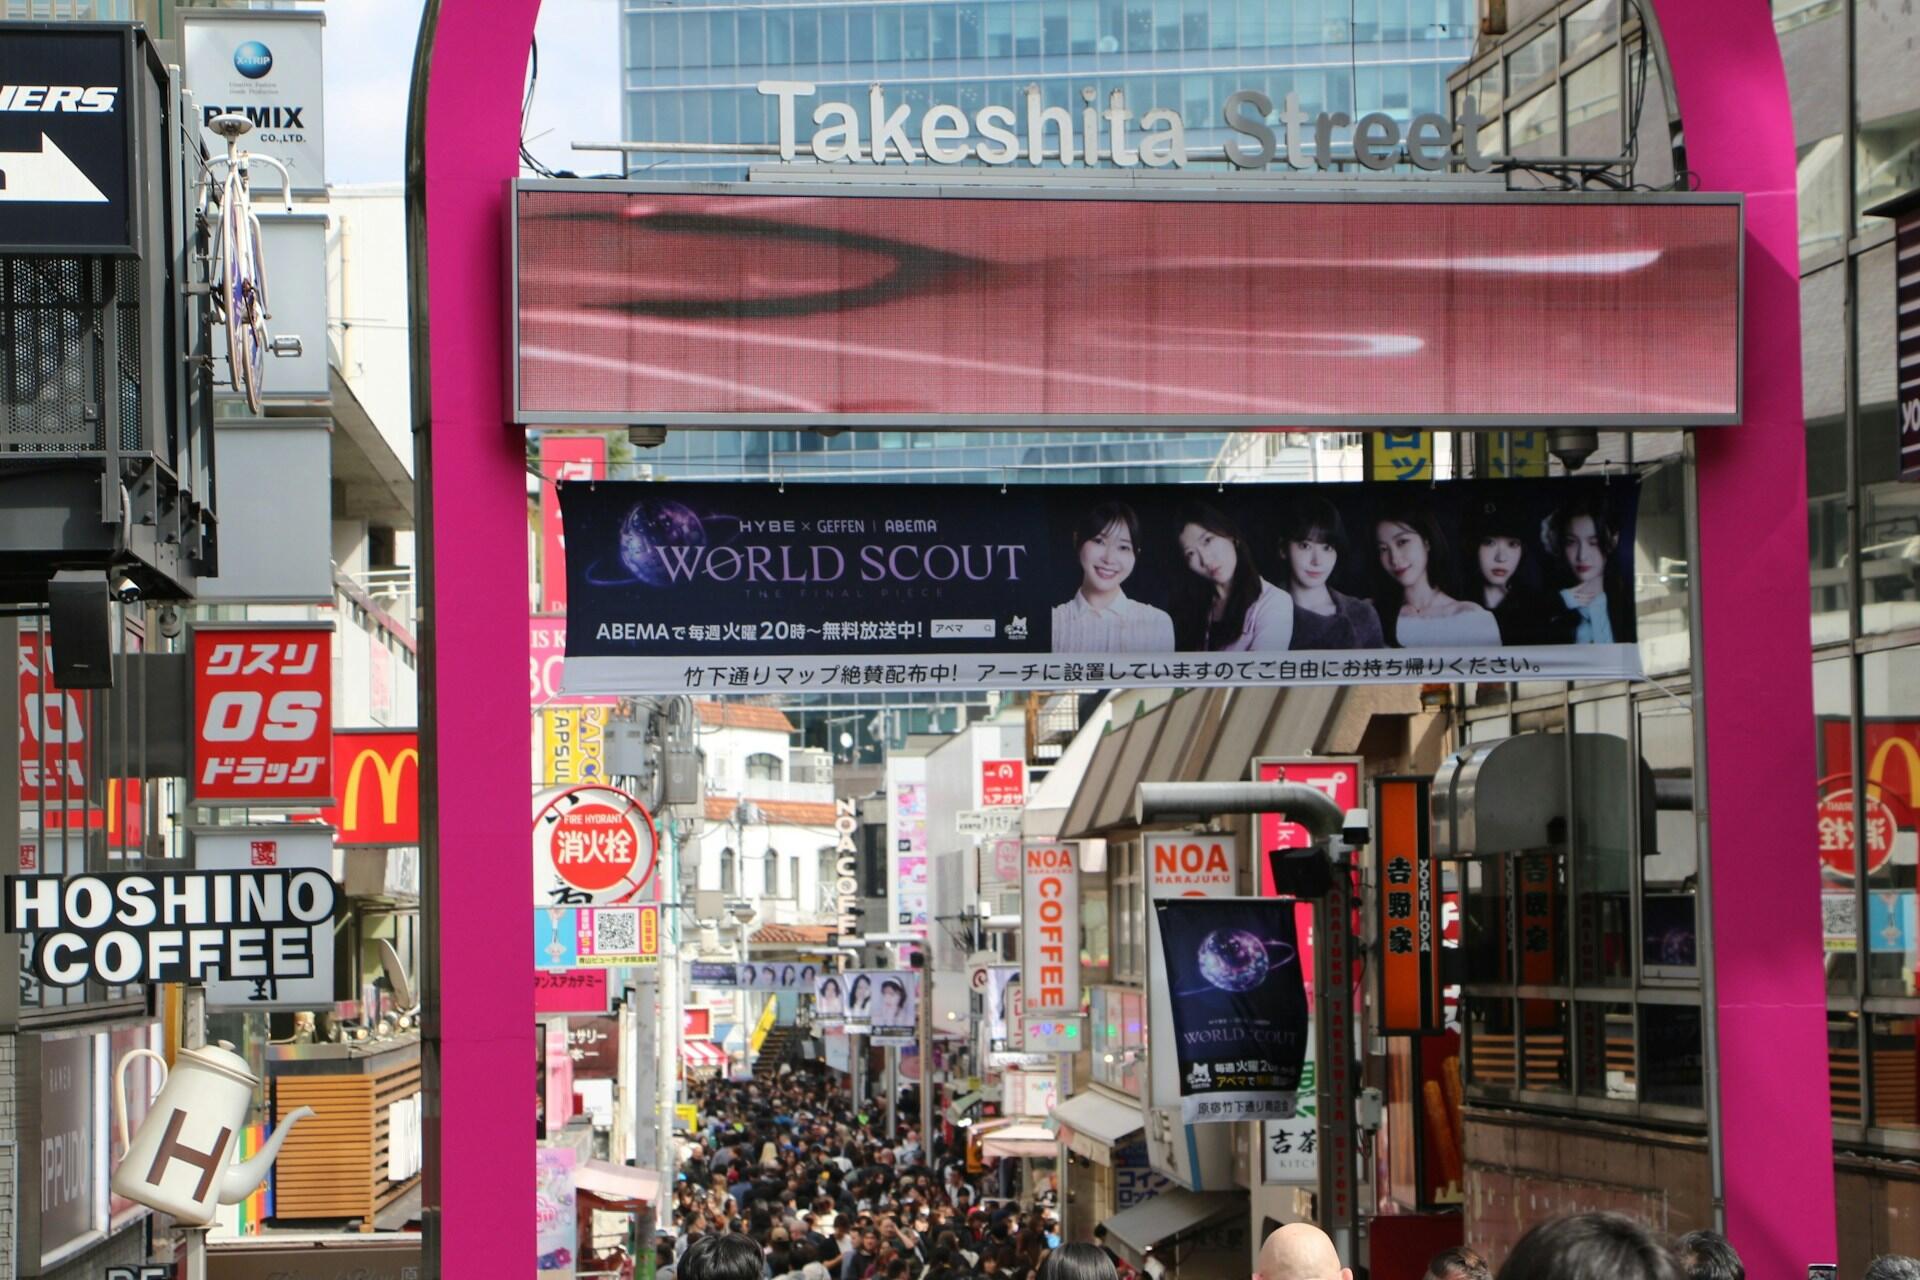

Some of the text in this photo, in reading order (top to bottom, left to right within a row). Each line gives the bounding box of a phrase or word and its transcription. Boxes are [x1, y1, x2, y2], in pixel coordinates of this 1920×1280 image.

[758, 80, 1495, 173] Takeshita Street
[739, 520, 796, 533] HYBE
[817, 520, 865, 533] GEFFEN
[885, 519, 937, 533] ABEMA
[655, 544, 1027, 584] WORLD SCOUT
[935, 623, 964, 634] アベマ
[206, 644, 318, 676] クスリ
[684, 656, 1541, 688] 竹下通りマップ絶賛配布中! アーチに設置していますのでご自由にお持ち帰りください。
[203, 691, 323, 742] OS
[202, 757, 325, 785] ドラッグ
[564, 814, 623, 825] FIRE HYDRANT
[557, 829, 632, 864] 消火栓
[1027, 850, 1072, 867] NOA
[1155, 844, 1228, 873] NOA
[1155, 875, 1231, 884] HARAJUKU
[15, 871, 334, 930] HOSHINO
[1418, 859, 1431, 952] YOSHINOYA
[43, 927, 310, 985] COFFEE
[1039, 877, 1064, 1007] COFFEE
[1184, 1027, 1246, 1045] WORLD
